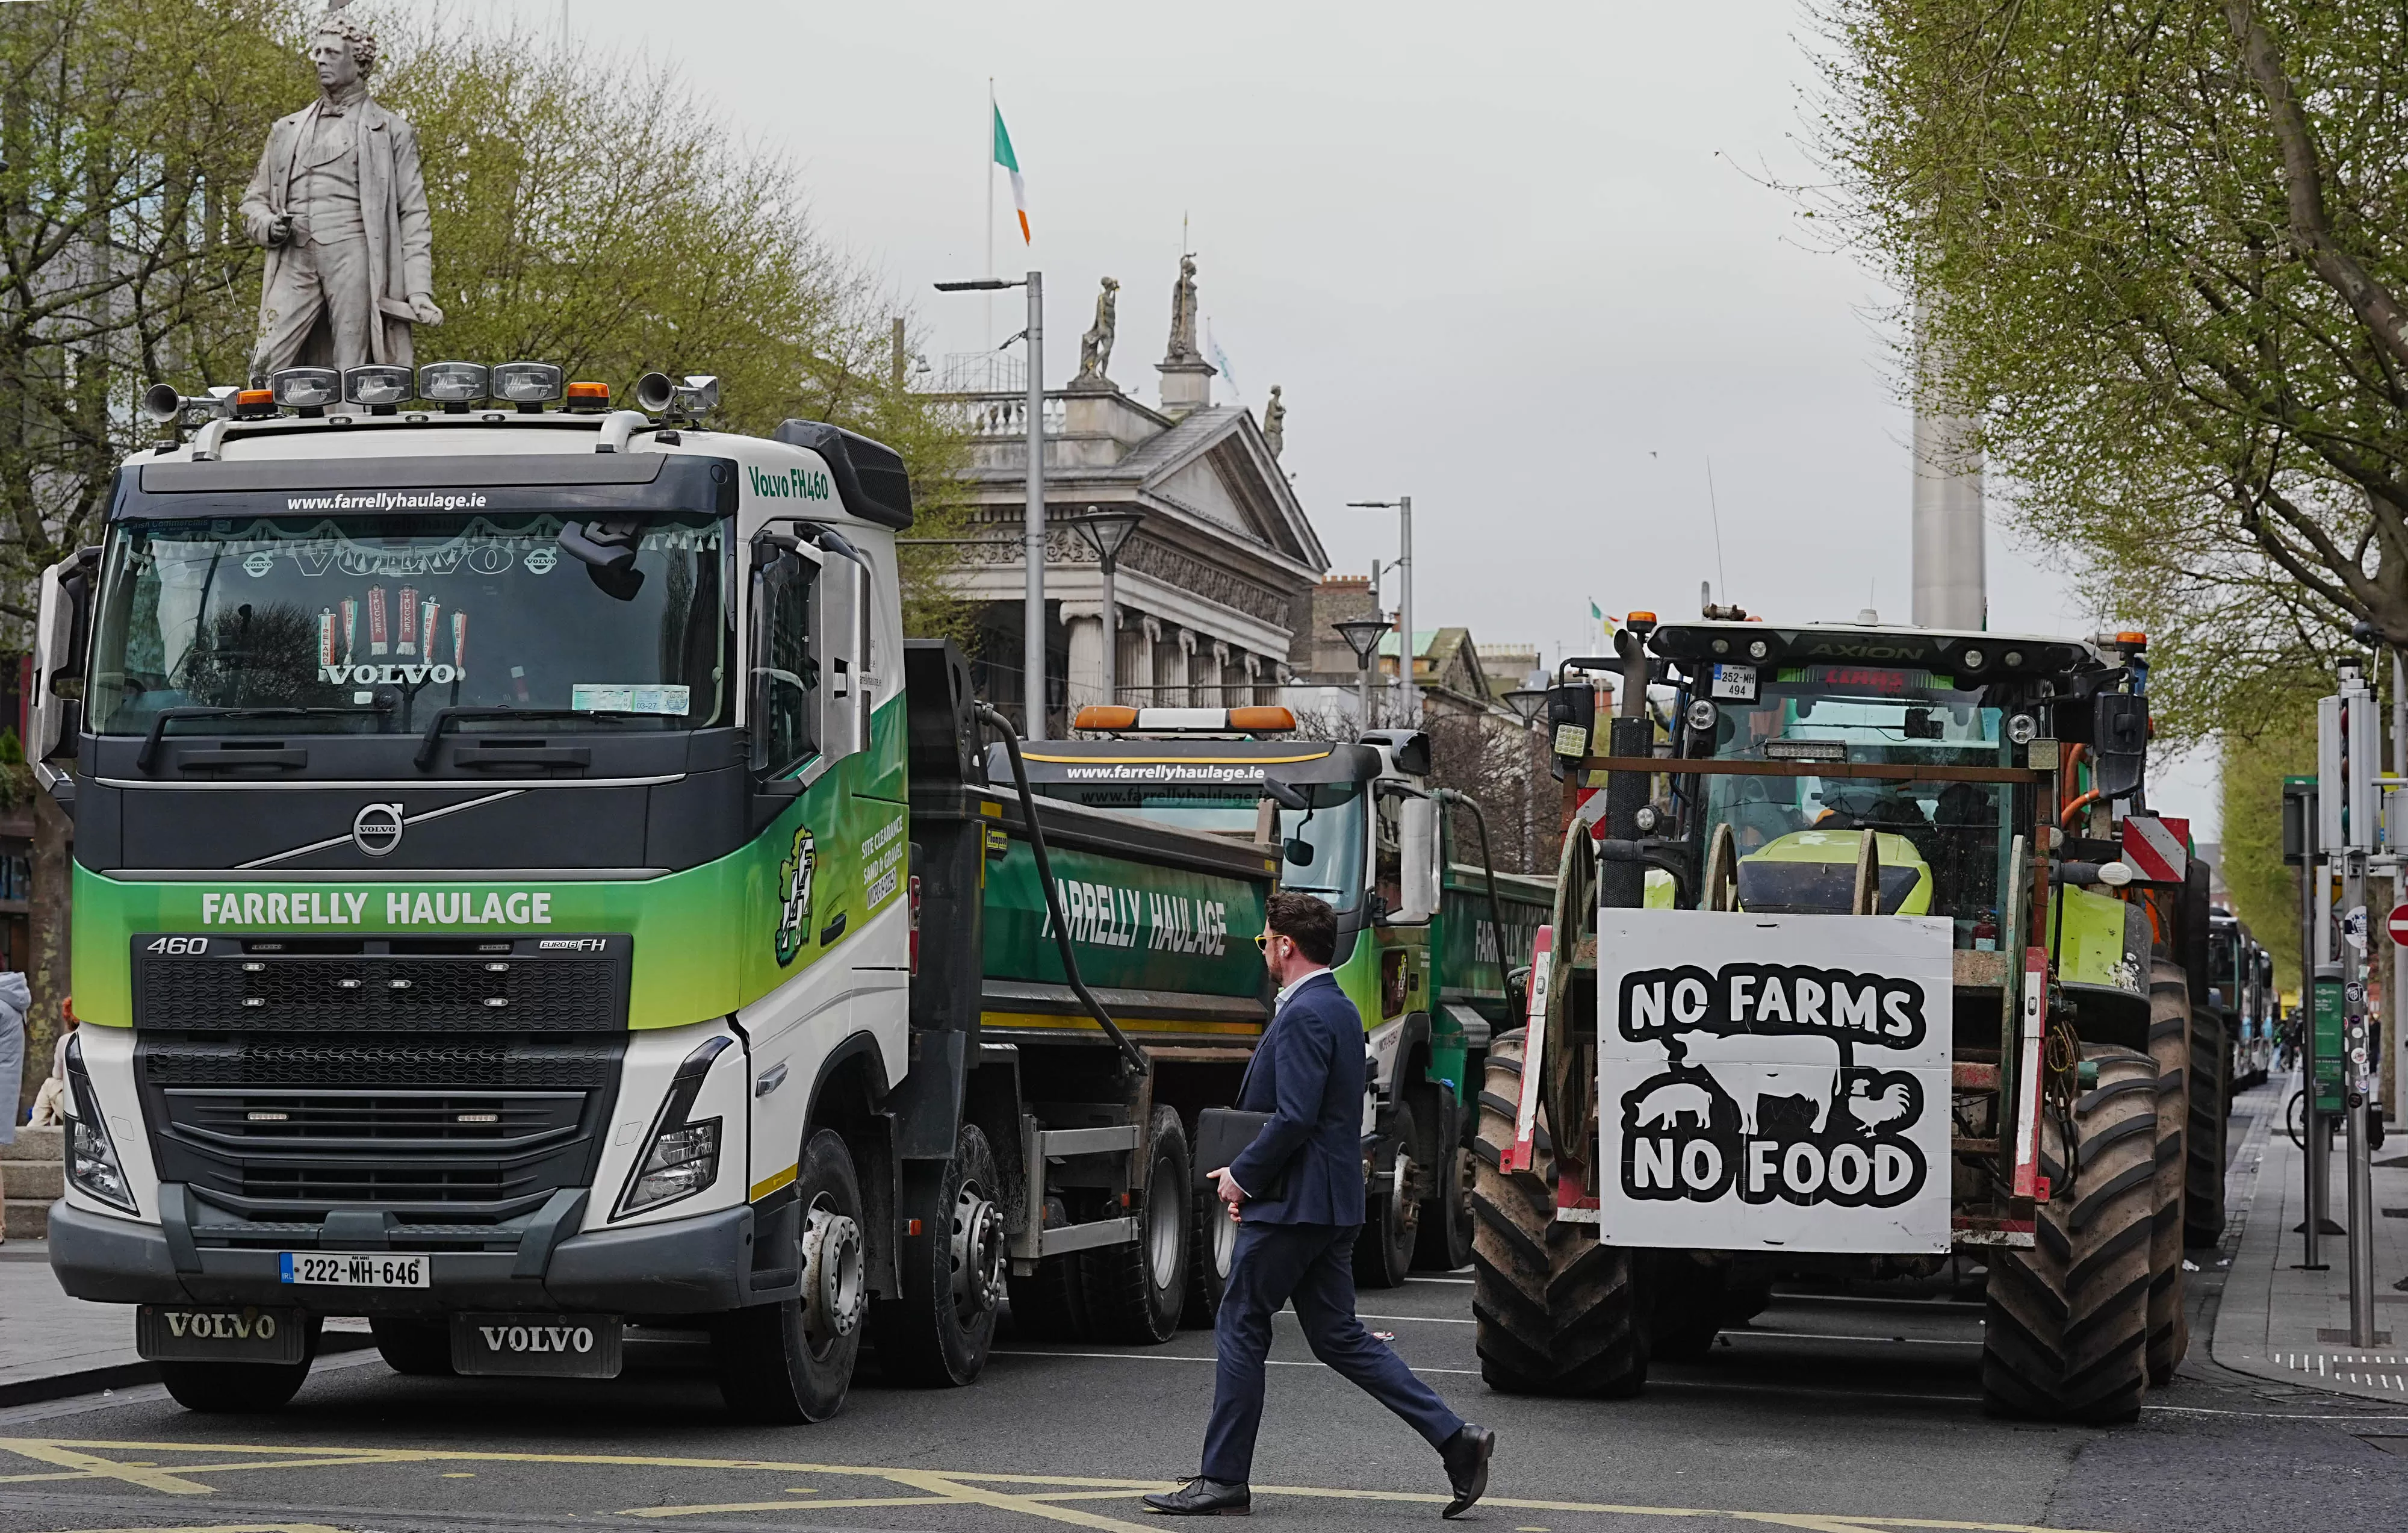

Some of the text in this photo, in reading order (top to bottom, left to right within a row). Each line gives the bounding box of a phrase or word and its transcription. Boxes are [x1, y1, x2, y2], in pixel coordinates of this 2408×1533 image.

[790, 468, 828, 501] FH460
[287, 493, 486, 511] www.farrellyhaulage.ie
[285, 546, 514, 576] VOLVO
[373, 594, 382, 633] TRUCKER
[1807, 643, 1925, 660] AXION
[321, 664, 455, 685] VOLVO
[1722, 671, 1755, 684] 252-MH
[1825, 669, 1905, 685] CLAAS
[1729, 685, 1746, 695] 494
[1067, 765, 1264, 781] www.farrellyhaulage.ie
[861, 815, 902, 859] SITE CLEARANCE
[864, 842, 902, 885] SAND & GRAVEL
[202, 892, 551, 924] FARRELLY HAULAGE
[1148, 892, 1227, 956] HAULAGE
[147, 937, 208, 955] 460
[1631, 975, 1914, 1038] NO FARMS
[1634, 1137, 1914, 1196] NO FOOD
[304, 1258, 419, 1285] 222-MH-646
[164, 1312, 276, 1340] VOLVO
[479, 1326, 593, 1353] VOLVO
